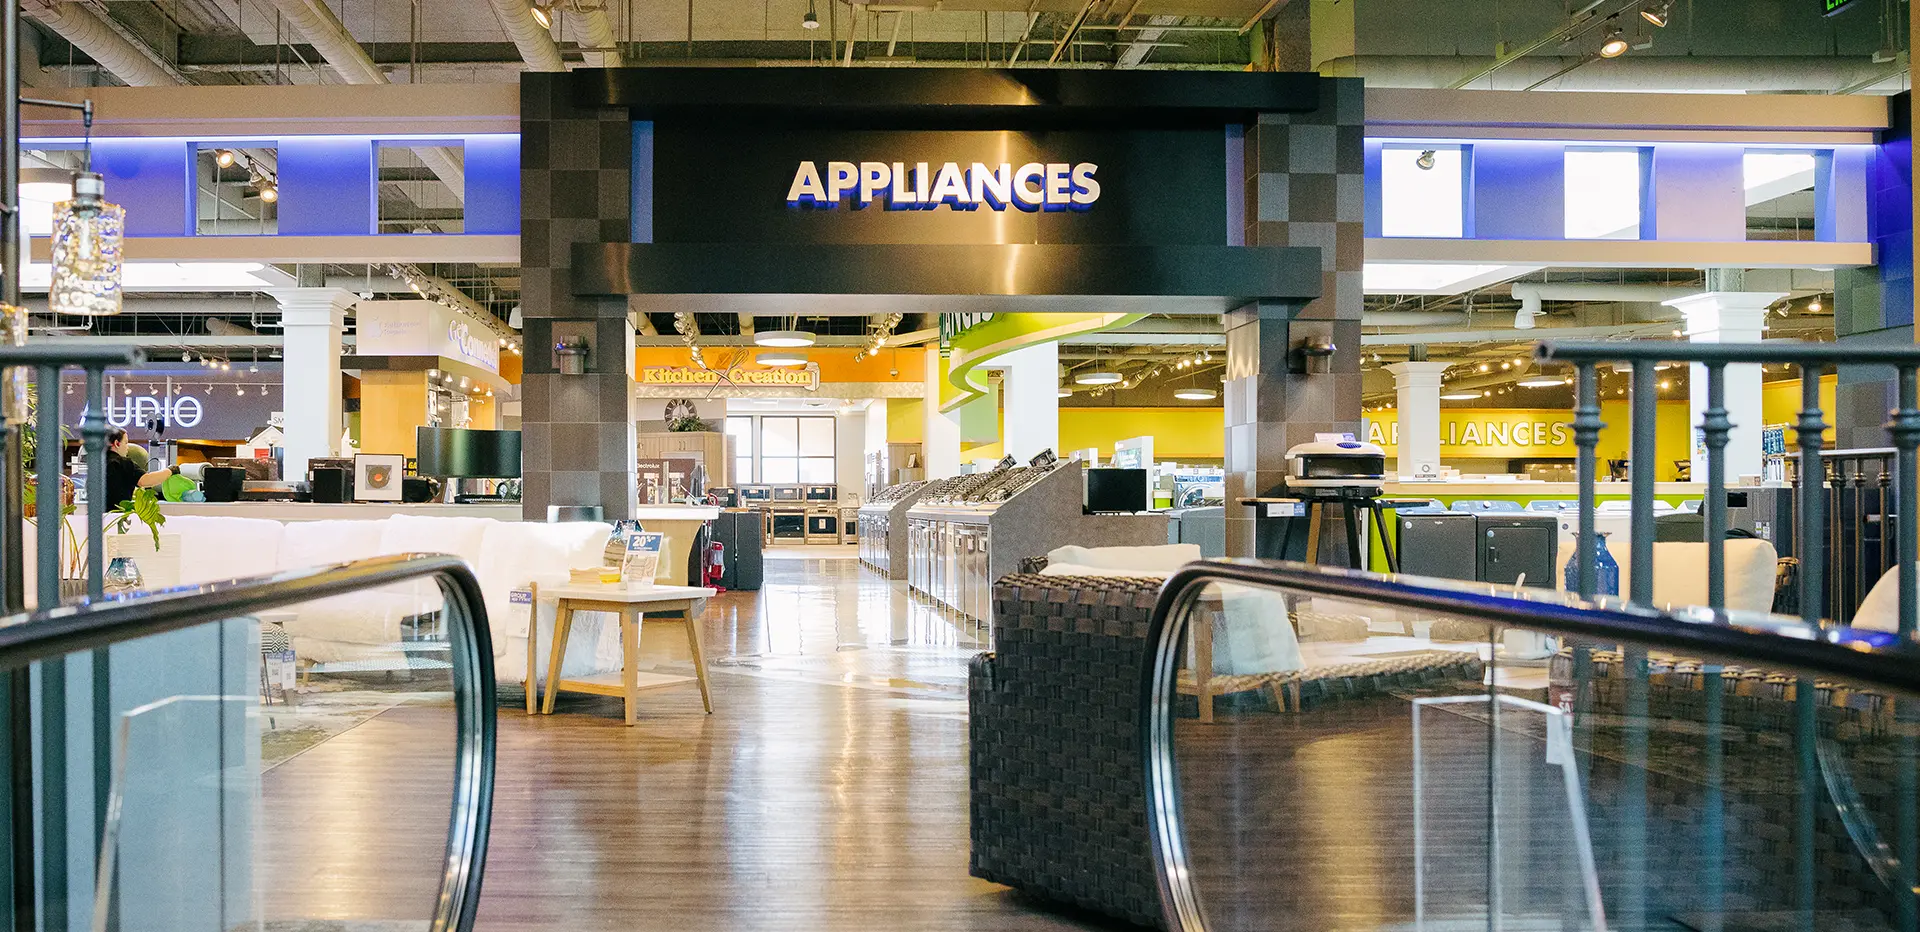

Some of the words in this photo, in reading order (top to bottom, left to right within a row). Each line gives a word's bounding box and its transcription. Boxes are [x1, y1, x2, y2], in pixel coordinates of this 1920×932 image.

[787, 161, 1101, 204] APPLIANCES
[643, 368, 718, 384] Kitchen
[728, 368, 812, 384] Creation
